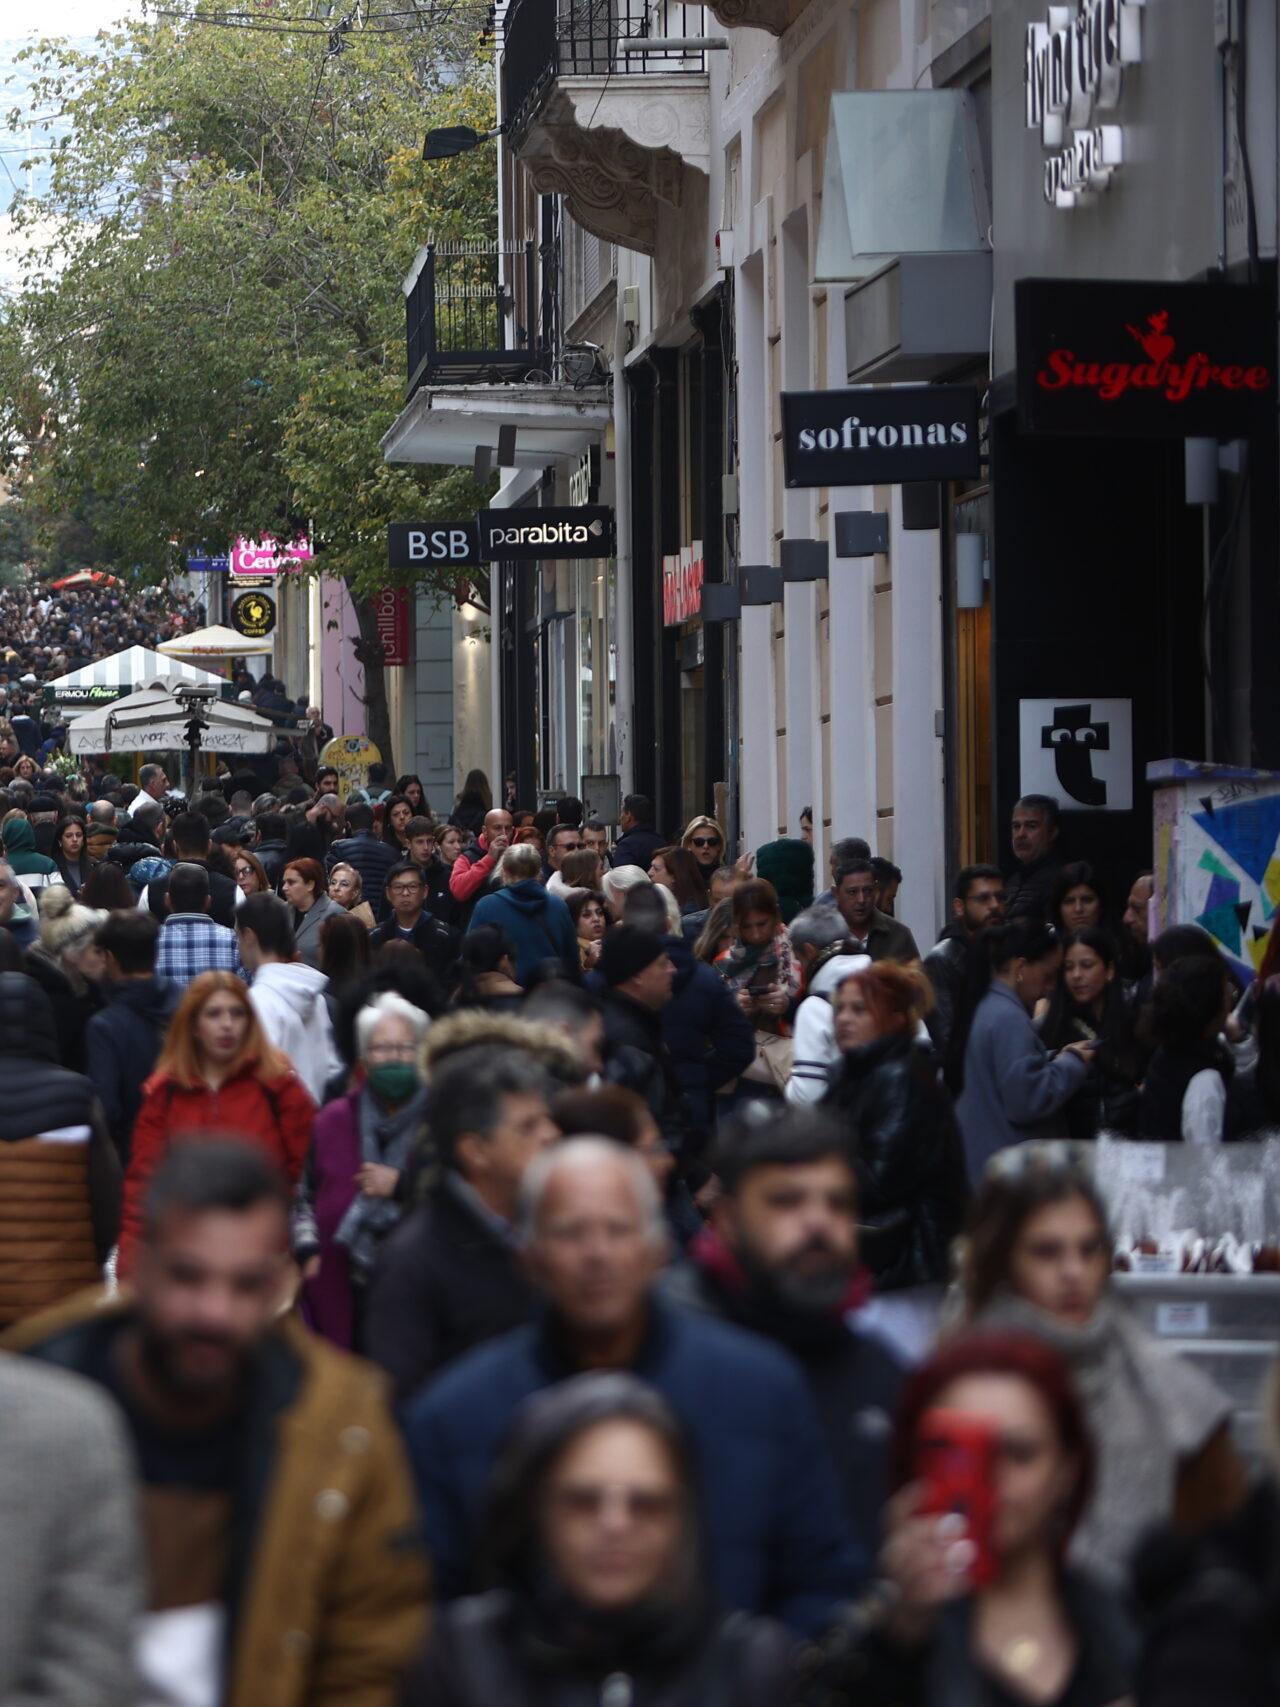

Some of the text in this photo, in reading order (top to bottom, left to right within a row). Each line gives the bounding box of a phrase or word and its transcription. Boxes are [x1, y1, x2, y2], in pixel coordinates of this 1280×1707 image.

[1036, 349, 1269, 402] Sugarfree
[798, 416, 968, 450] sofronas
[408, 530, 469, 560] BSB
[489, 522, 588, 548] parabita
[55, 687, 119, 698] ERMOU Flower
